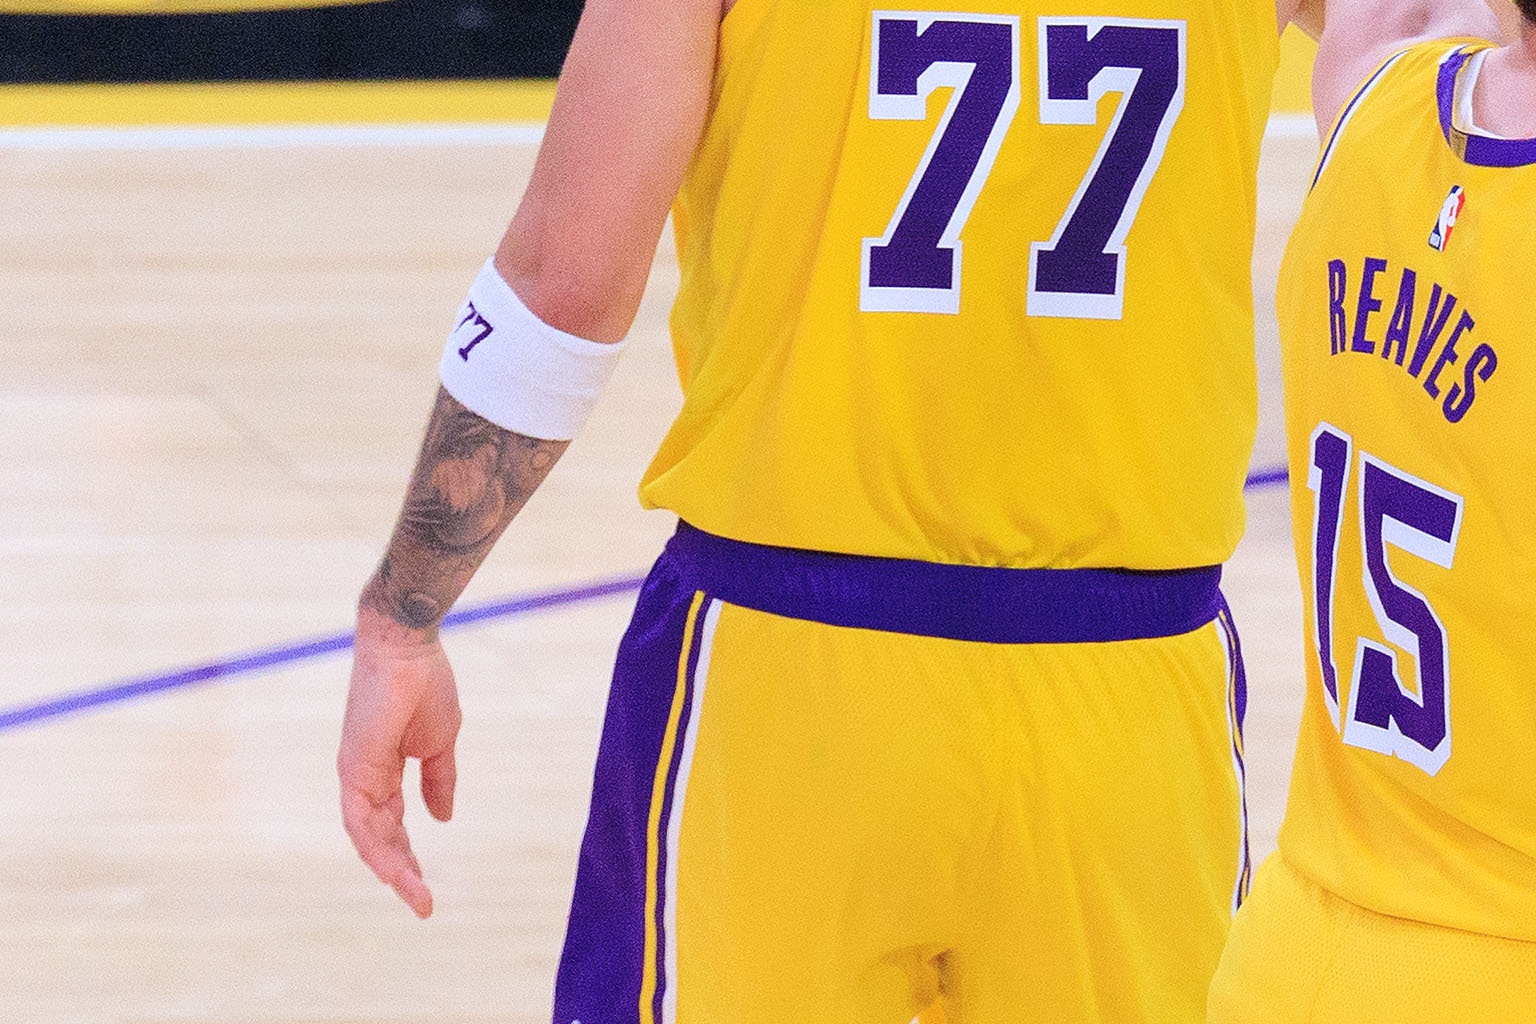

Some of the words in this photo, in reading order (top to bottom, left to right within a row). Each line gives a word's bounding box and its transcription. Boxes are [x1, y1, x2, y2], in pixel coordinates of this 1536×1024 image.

[859, 9, 1188, 321] 77
[454, 300, 494, 362] 77
[1327, 256, 1499, 424] REAVES
[1306, 420, 1465, 777] 15
